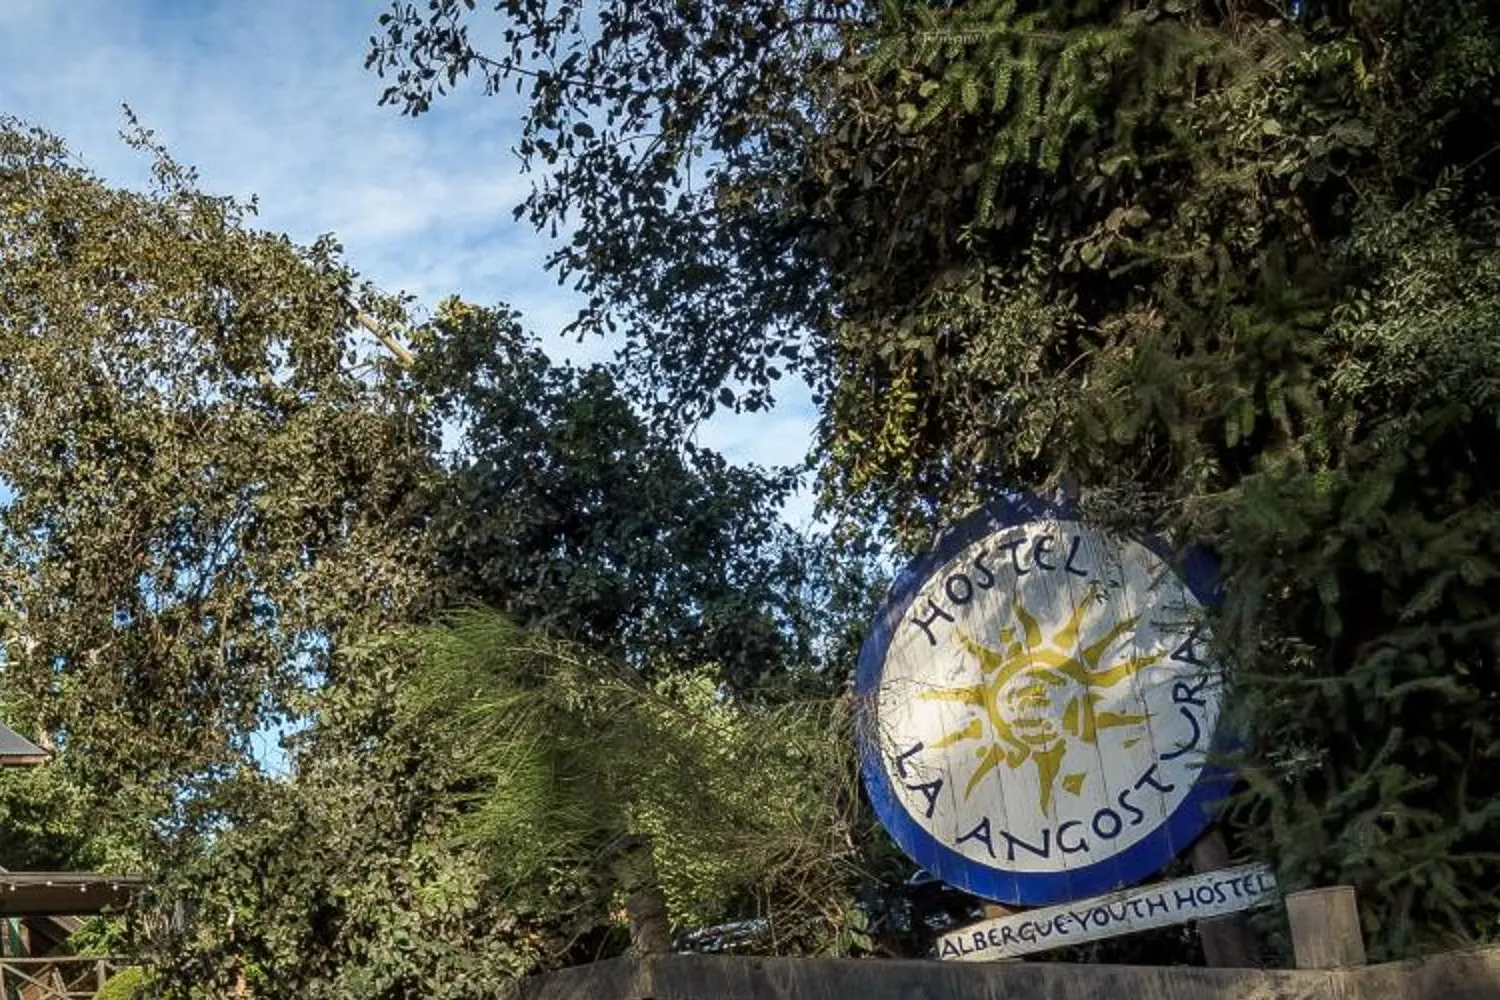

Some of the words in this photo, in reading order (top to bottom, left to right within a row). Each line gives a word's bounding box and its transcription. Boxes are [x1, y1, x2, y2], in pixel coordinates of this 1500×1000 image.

[910, 533, 1093, 647] HOSTEL
[896, 740, 945, 819] LA
[955, 629, 1209, 862] ANGOSTURA
[1175, 871, 1276, 911] HOSTEL
